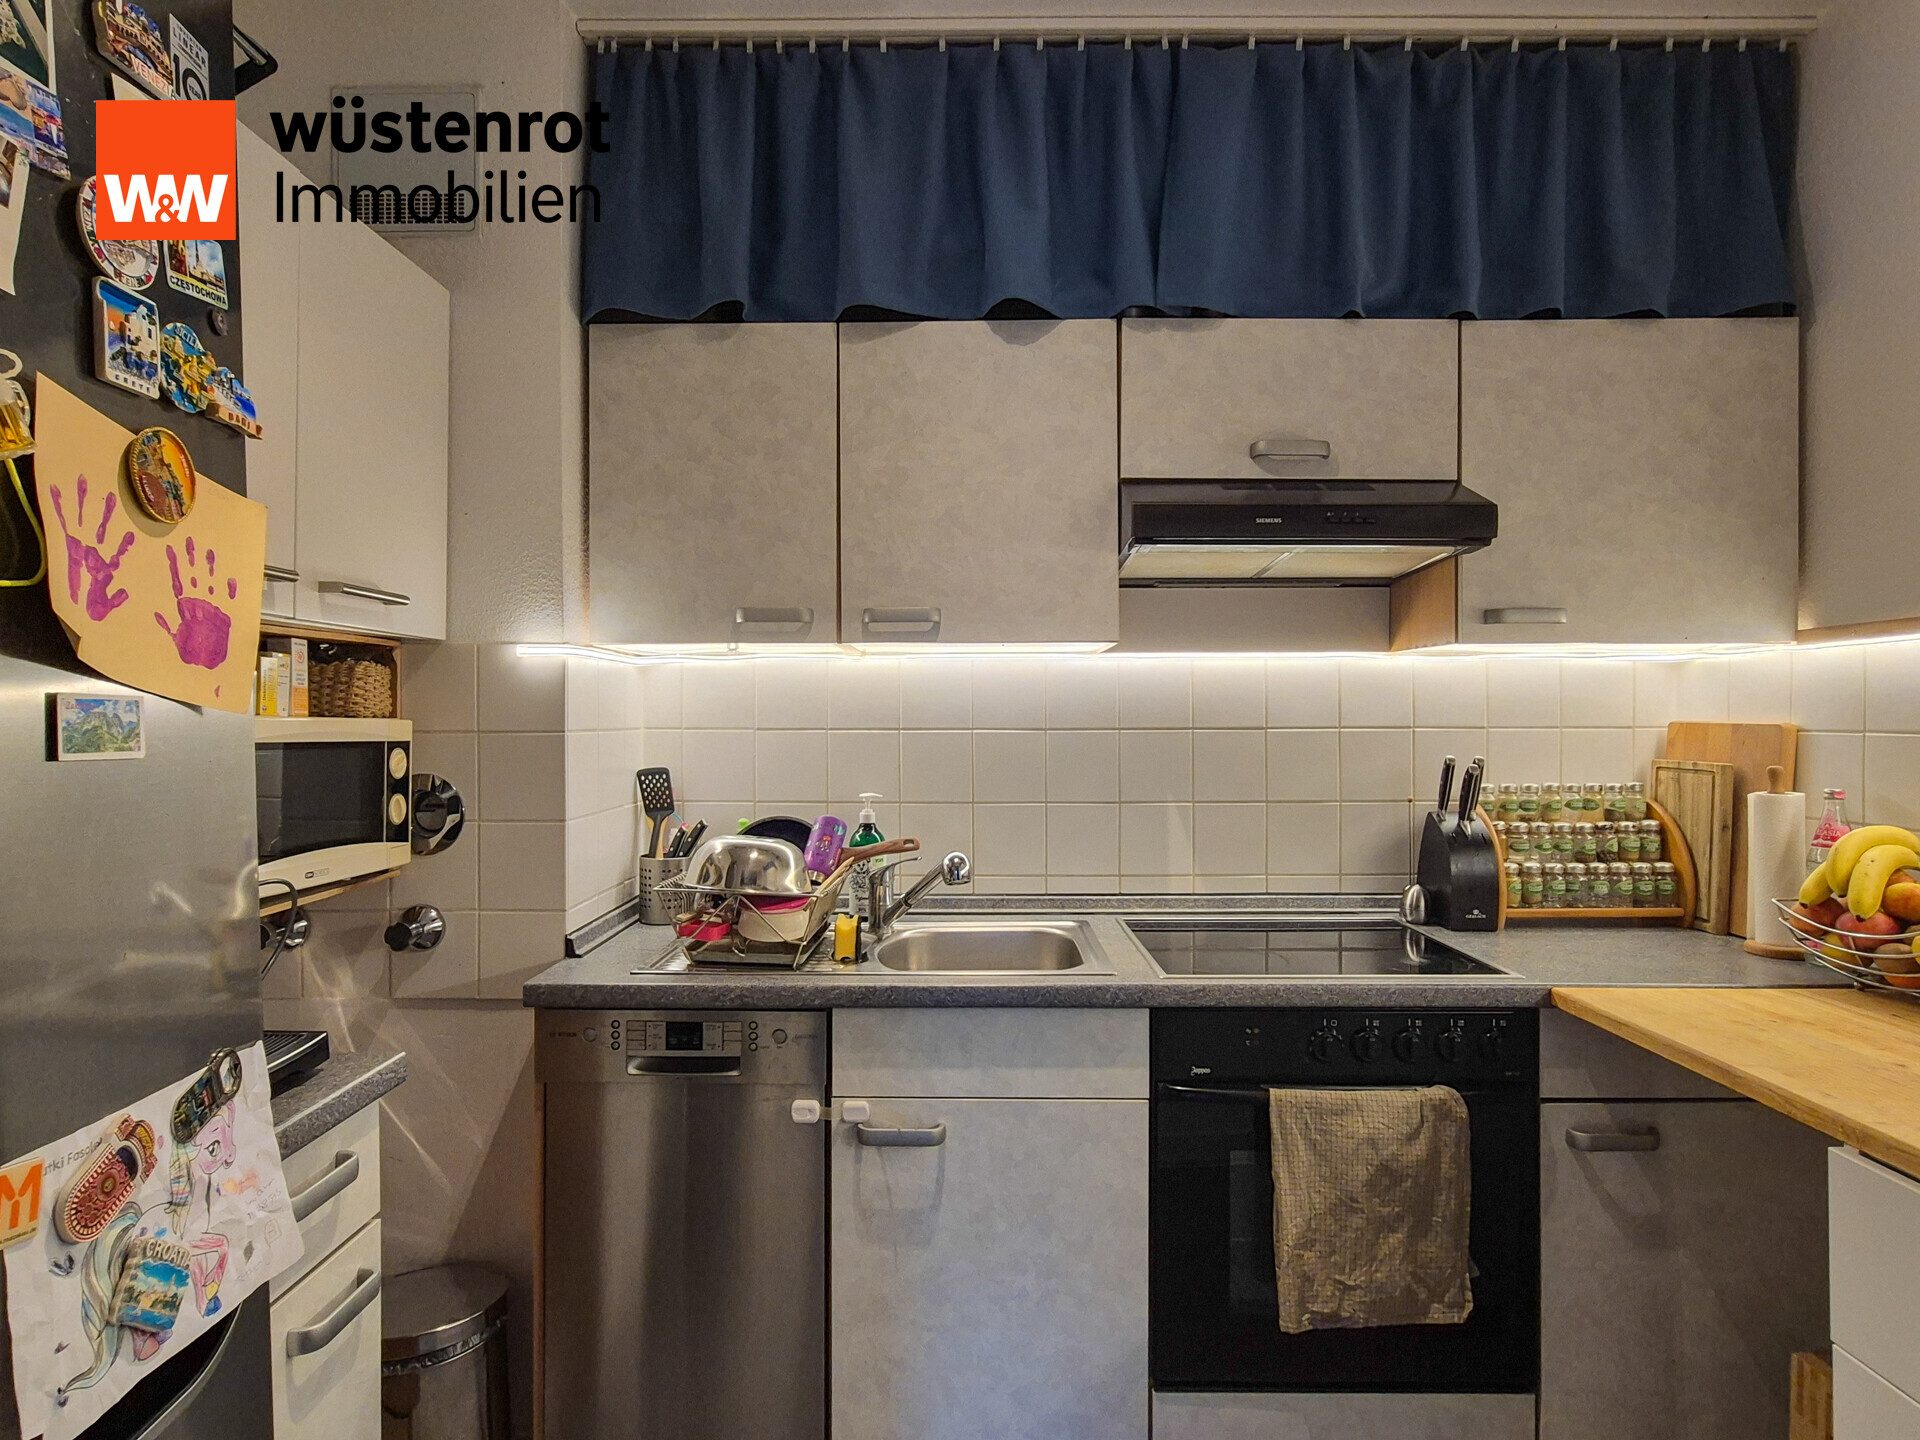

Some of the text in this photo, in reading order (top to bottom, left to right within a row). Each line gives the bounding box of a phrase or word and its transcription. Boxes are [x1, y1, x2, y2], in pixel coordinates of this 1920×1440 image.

[173, 26, 206, 68] LINEAR
[132, 57, 173, 99] VENEZI
[228, 412, 251, 430] BARI
